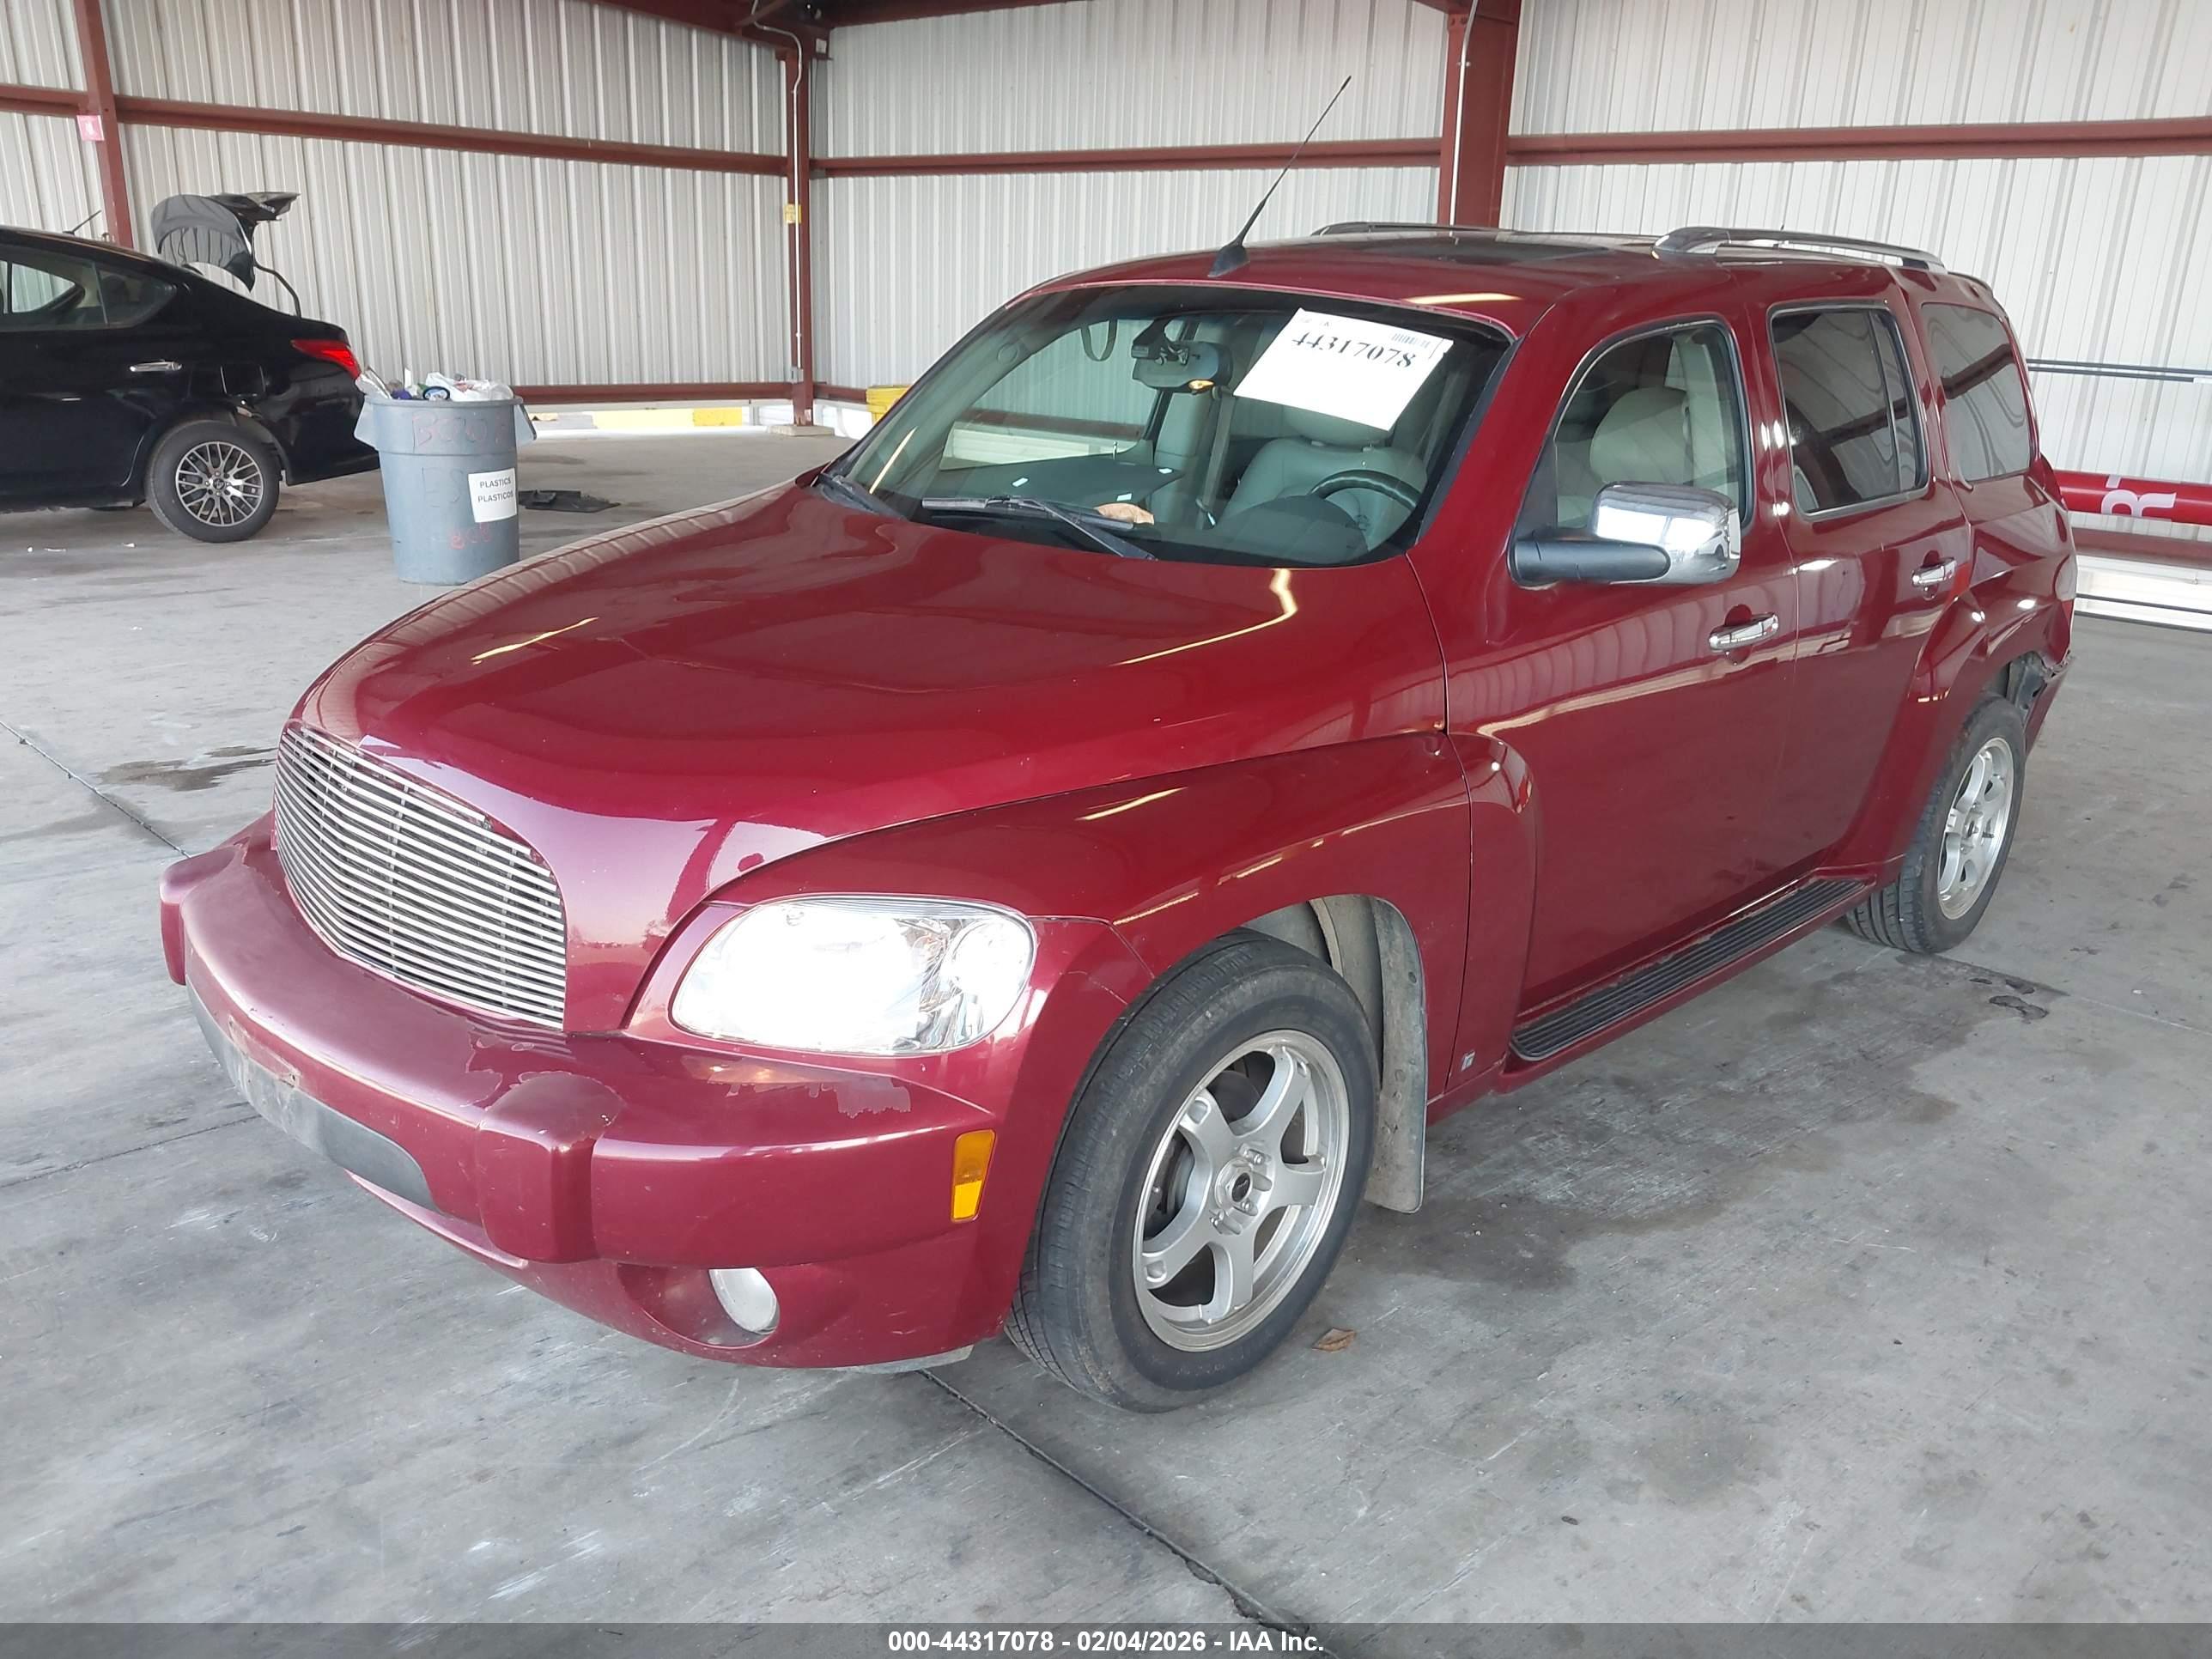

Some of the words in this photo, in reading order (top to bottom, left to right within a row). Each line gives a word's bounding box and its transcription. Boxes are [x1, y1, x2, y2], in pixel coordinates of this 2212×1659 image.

[1292, 331, 1416, 368] 44317078
[479, 477, 512, 489] PLASTICS
[477, 489, 514, 502] PLASTICOS
